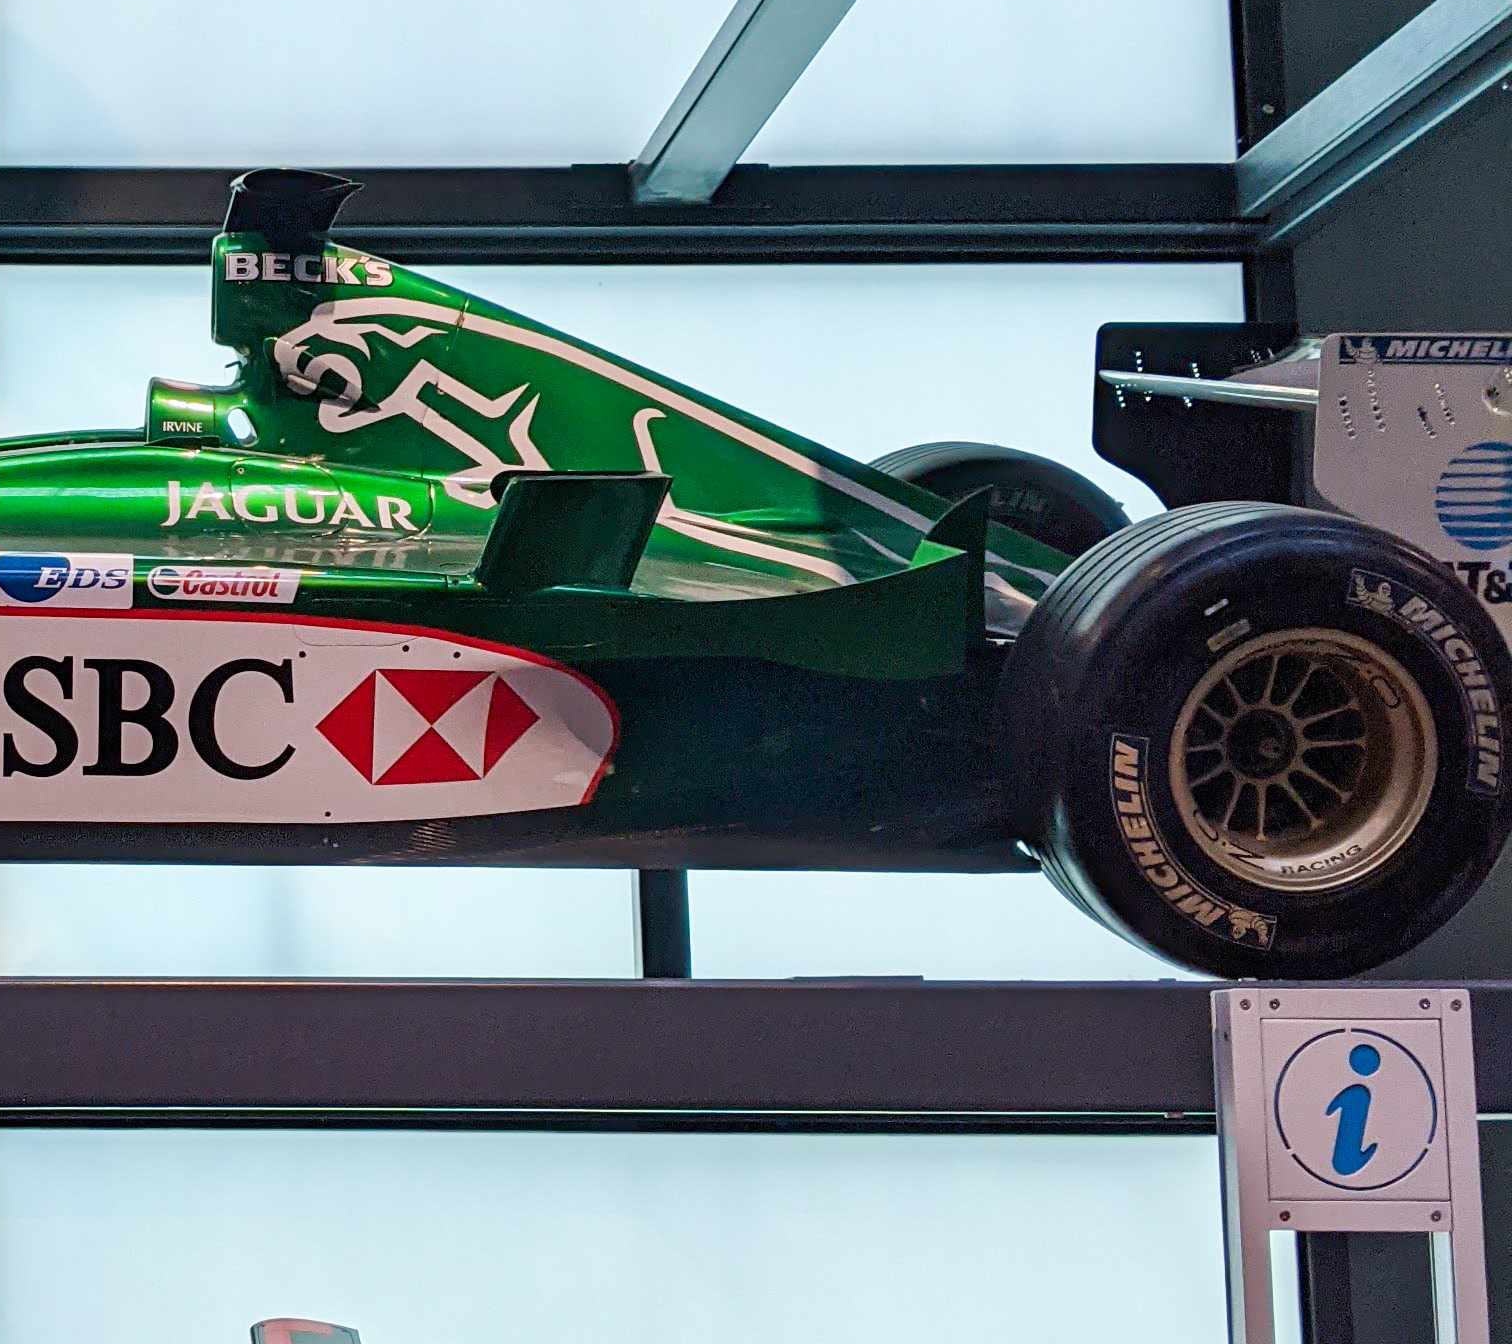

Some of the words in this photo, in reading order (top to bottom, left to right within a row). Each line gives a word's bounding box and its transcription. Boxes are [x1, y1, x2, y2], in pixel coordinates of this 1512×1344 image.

[223, 251, 394, 288] BECK'S
[1385, 339, 1512, 359] MICHEL
[161, 420, 204, 434] IRVINE
[160, 479, 420, 533] JAGUAR
[33, 565, 130, 590] EDS
[180, 568, 280, 598] Castrol
[1398, 595, 1502, 790] MICHELIN
[1113, 739, 1230, 927] MICHELIN
[1280, 843, 1364, 875] RACING
